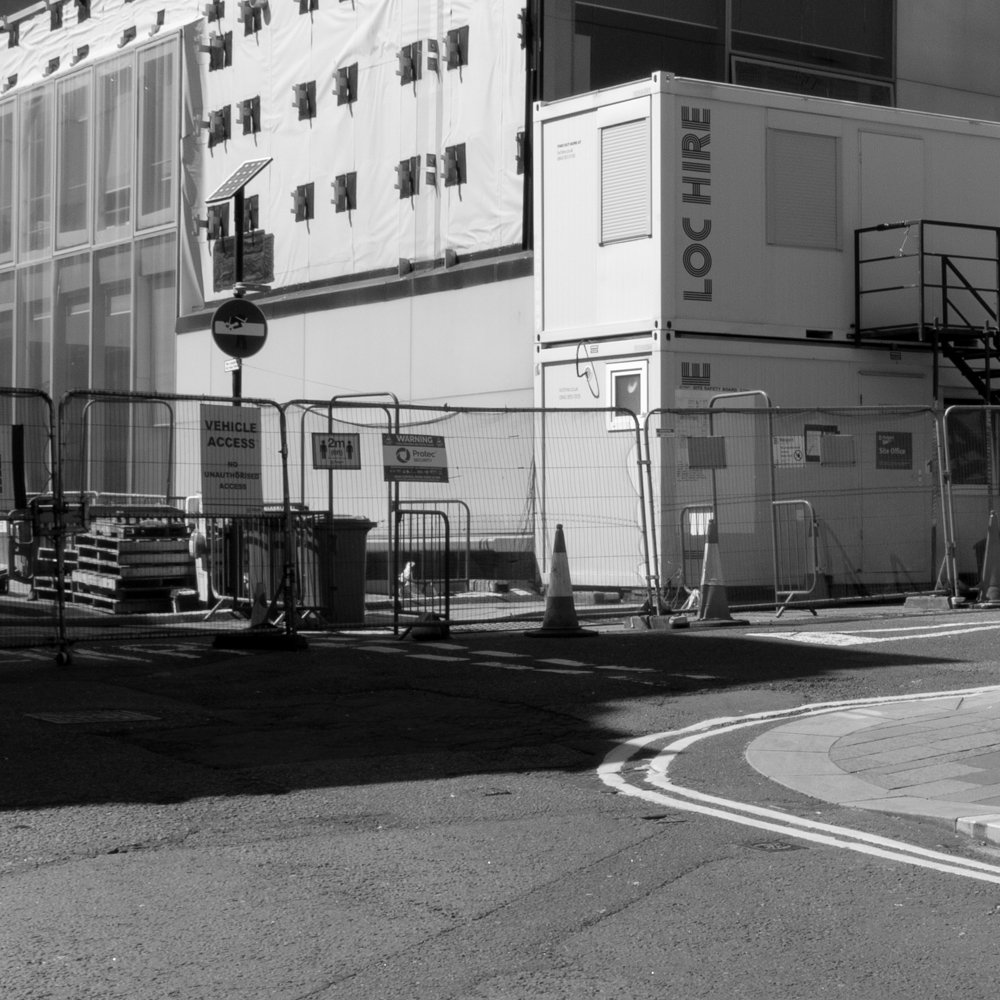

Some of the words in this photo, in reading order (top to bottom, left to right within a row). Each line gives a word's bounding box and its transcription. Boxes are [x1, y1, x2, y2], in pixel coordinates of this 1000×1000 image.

[681, 105, 711, 205] HIRE
[682, 217, 713, 302] LOC
[205, 420, 257, 433] VEHICLE
[207, 436, 255, 449] ACCESS
[327, 437, 345, 448] 2m
[396, 434, 433, 444] WARNING
[204, 471, 259, 480] UNAUTHORISED
